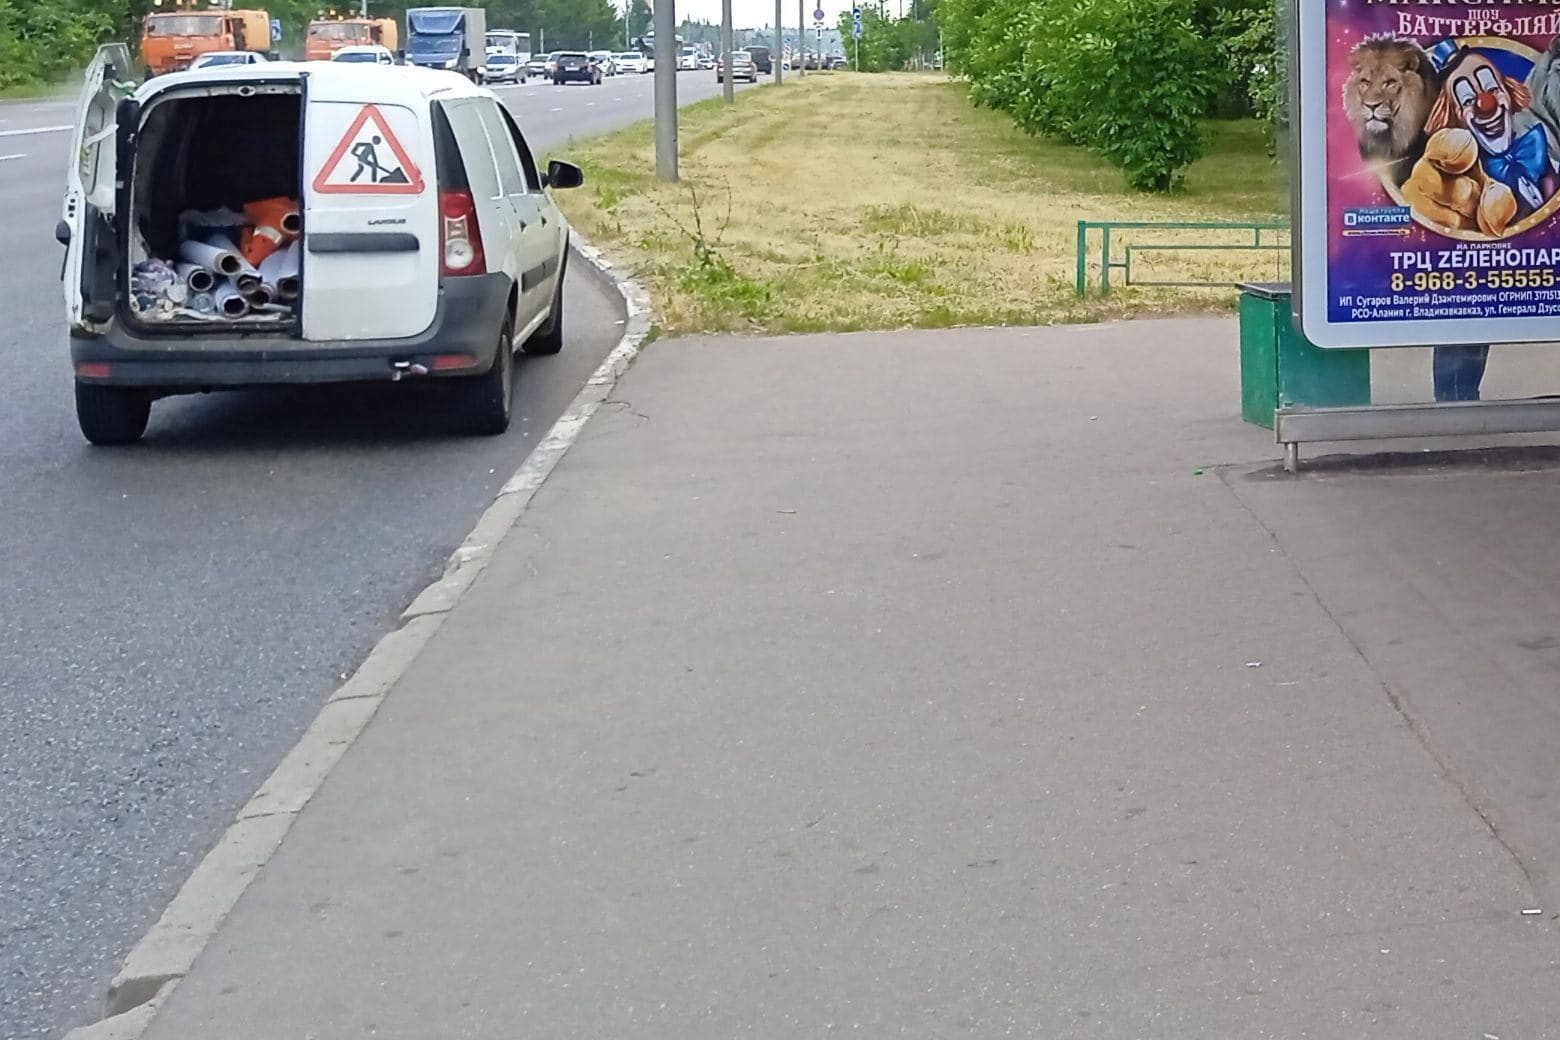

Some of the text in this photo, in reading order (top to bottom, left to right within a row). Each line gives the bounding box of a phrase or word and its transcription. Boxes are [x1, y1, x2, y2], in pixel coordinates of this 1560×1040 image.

[1467, 9, 1500, 21] ШОУ
[1390, 251, 1432, 271] ТРЦ
[1339, 296, 1353, 307] ИП
[1357, 295, 1391, 308] Сугаров
[1393, 293, 1429, 306] Валерий
[1431, 292, 1497, 305] Дзантемирович
[1499, 291, 1533, 302] ОГРНИП
[1352, 307, 1404, 319] РСО-Алания
[1484, 306, 1497, 317] ул.
[1498, 304, 1536, 314] Генерала
